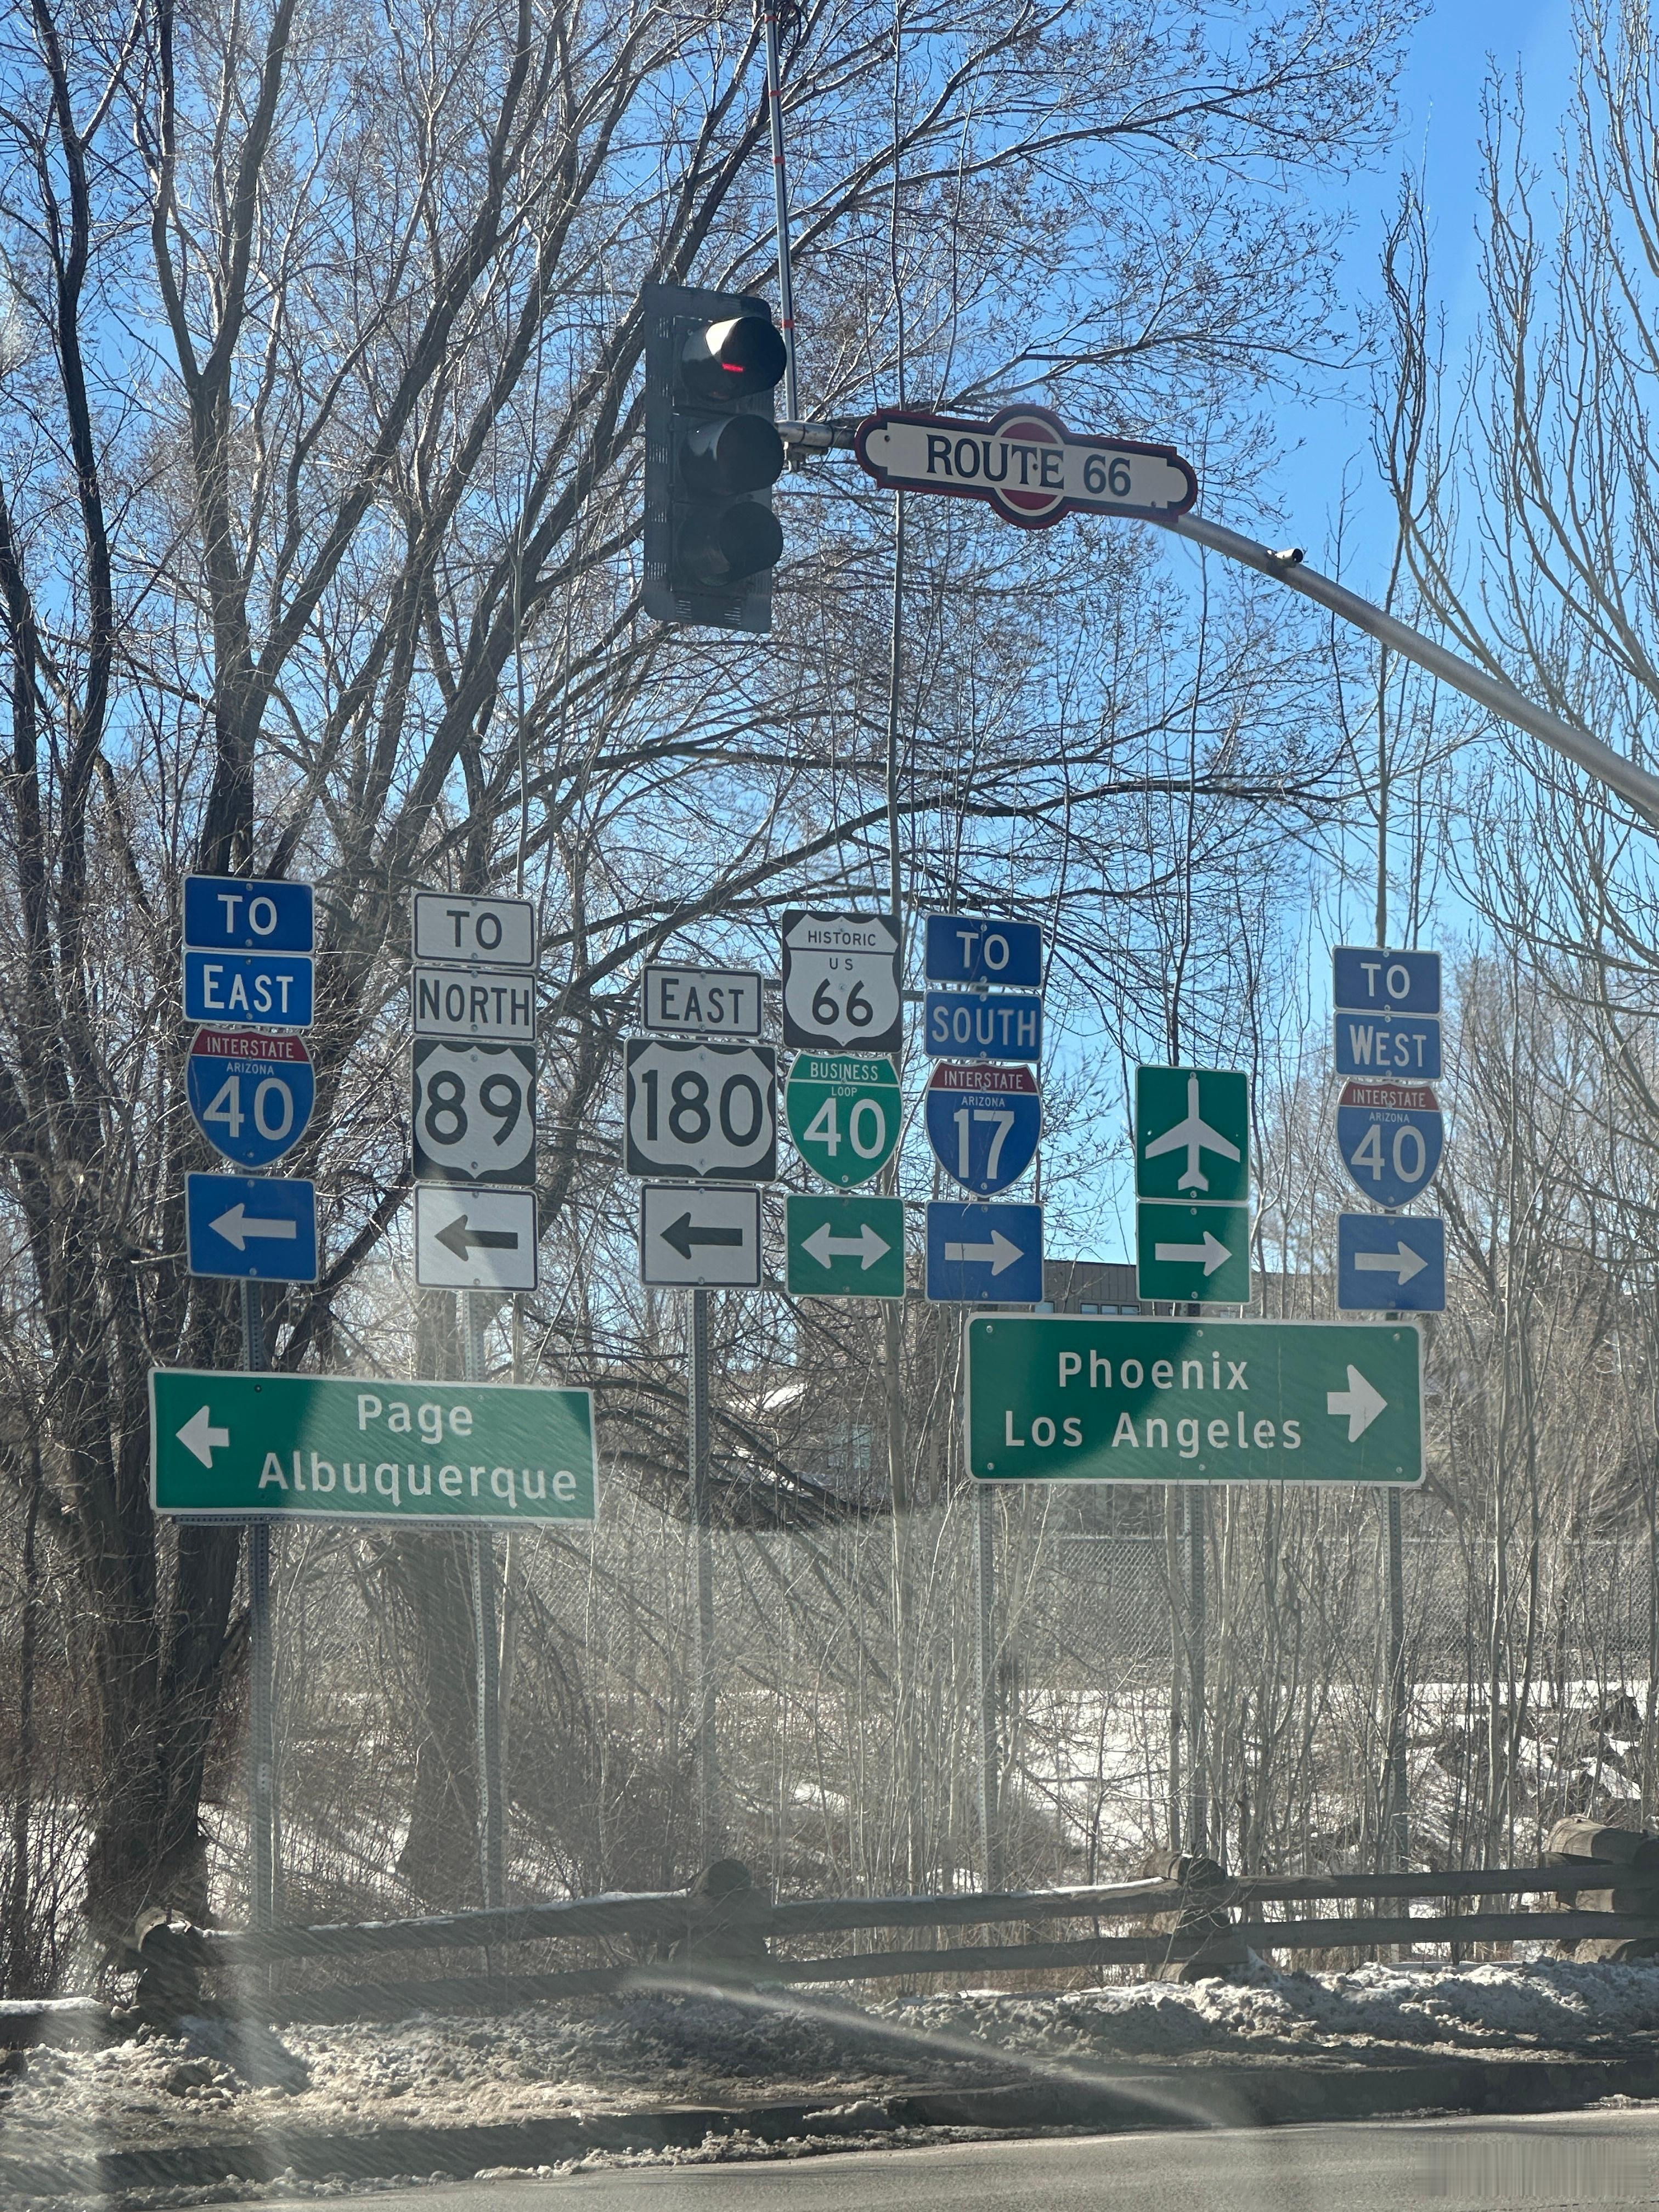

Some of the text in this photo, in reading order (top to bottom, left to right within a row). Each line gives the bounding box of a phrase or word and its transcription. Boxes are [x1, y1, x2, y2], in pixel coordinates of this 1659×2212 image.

[927, 434, 1131, 496] ROUTE 66
[218, 894, 277, 935] TO
[447, 911, 503, 950] TO
[808, 930, 876, 946] HISTORIC
[957, 931, 1009, 970] TO
[204, 965, 294, 1014] EAST
[419, 978, 530, 1026] NORTH
[661, 978, 744, 1024] EAST
[1361, 963, 1410, 1000] TO
[812, 978, 873, 1028] 66
[207, 1036, 294, 1059] INTERSTATE
[932, 1006, 1036, 1047] SOUTH
[1350, 1024, 1426, 1068] WEST
[227, 1062, 274, 1075] ARIZONA
[810, 1062, 878, 1081] BUSINESS
[945, 1072, 1023, 1091] INTERSTATE
[203, 1076, 294, 1141] 40
[424, 1070, 523, 1147] 89
[641, 1069, 763, 1148] 180
[831, 1086, 857, 1097] LOOP
[962, 1096, 1005, 1108] ARIZONA
[1353, 1088, 1425, 1108] INTERSTATE
[804, 1097, 886, 1159] 40
[1369, 1112, 1410, 1124] ARIZONA
[953, 1109, 1015, 1180] 17
[1351, 1124, 1426, 1183] 40
[1059, 1350, 1249, 1391] Phoenix
[358, 1394, 473, 1444] Page
[1005, 1409, 1302, 1459] Los Angeles
[258, 1452, 577, 1509] Albuquerque
